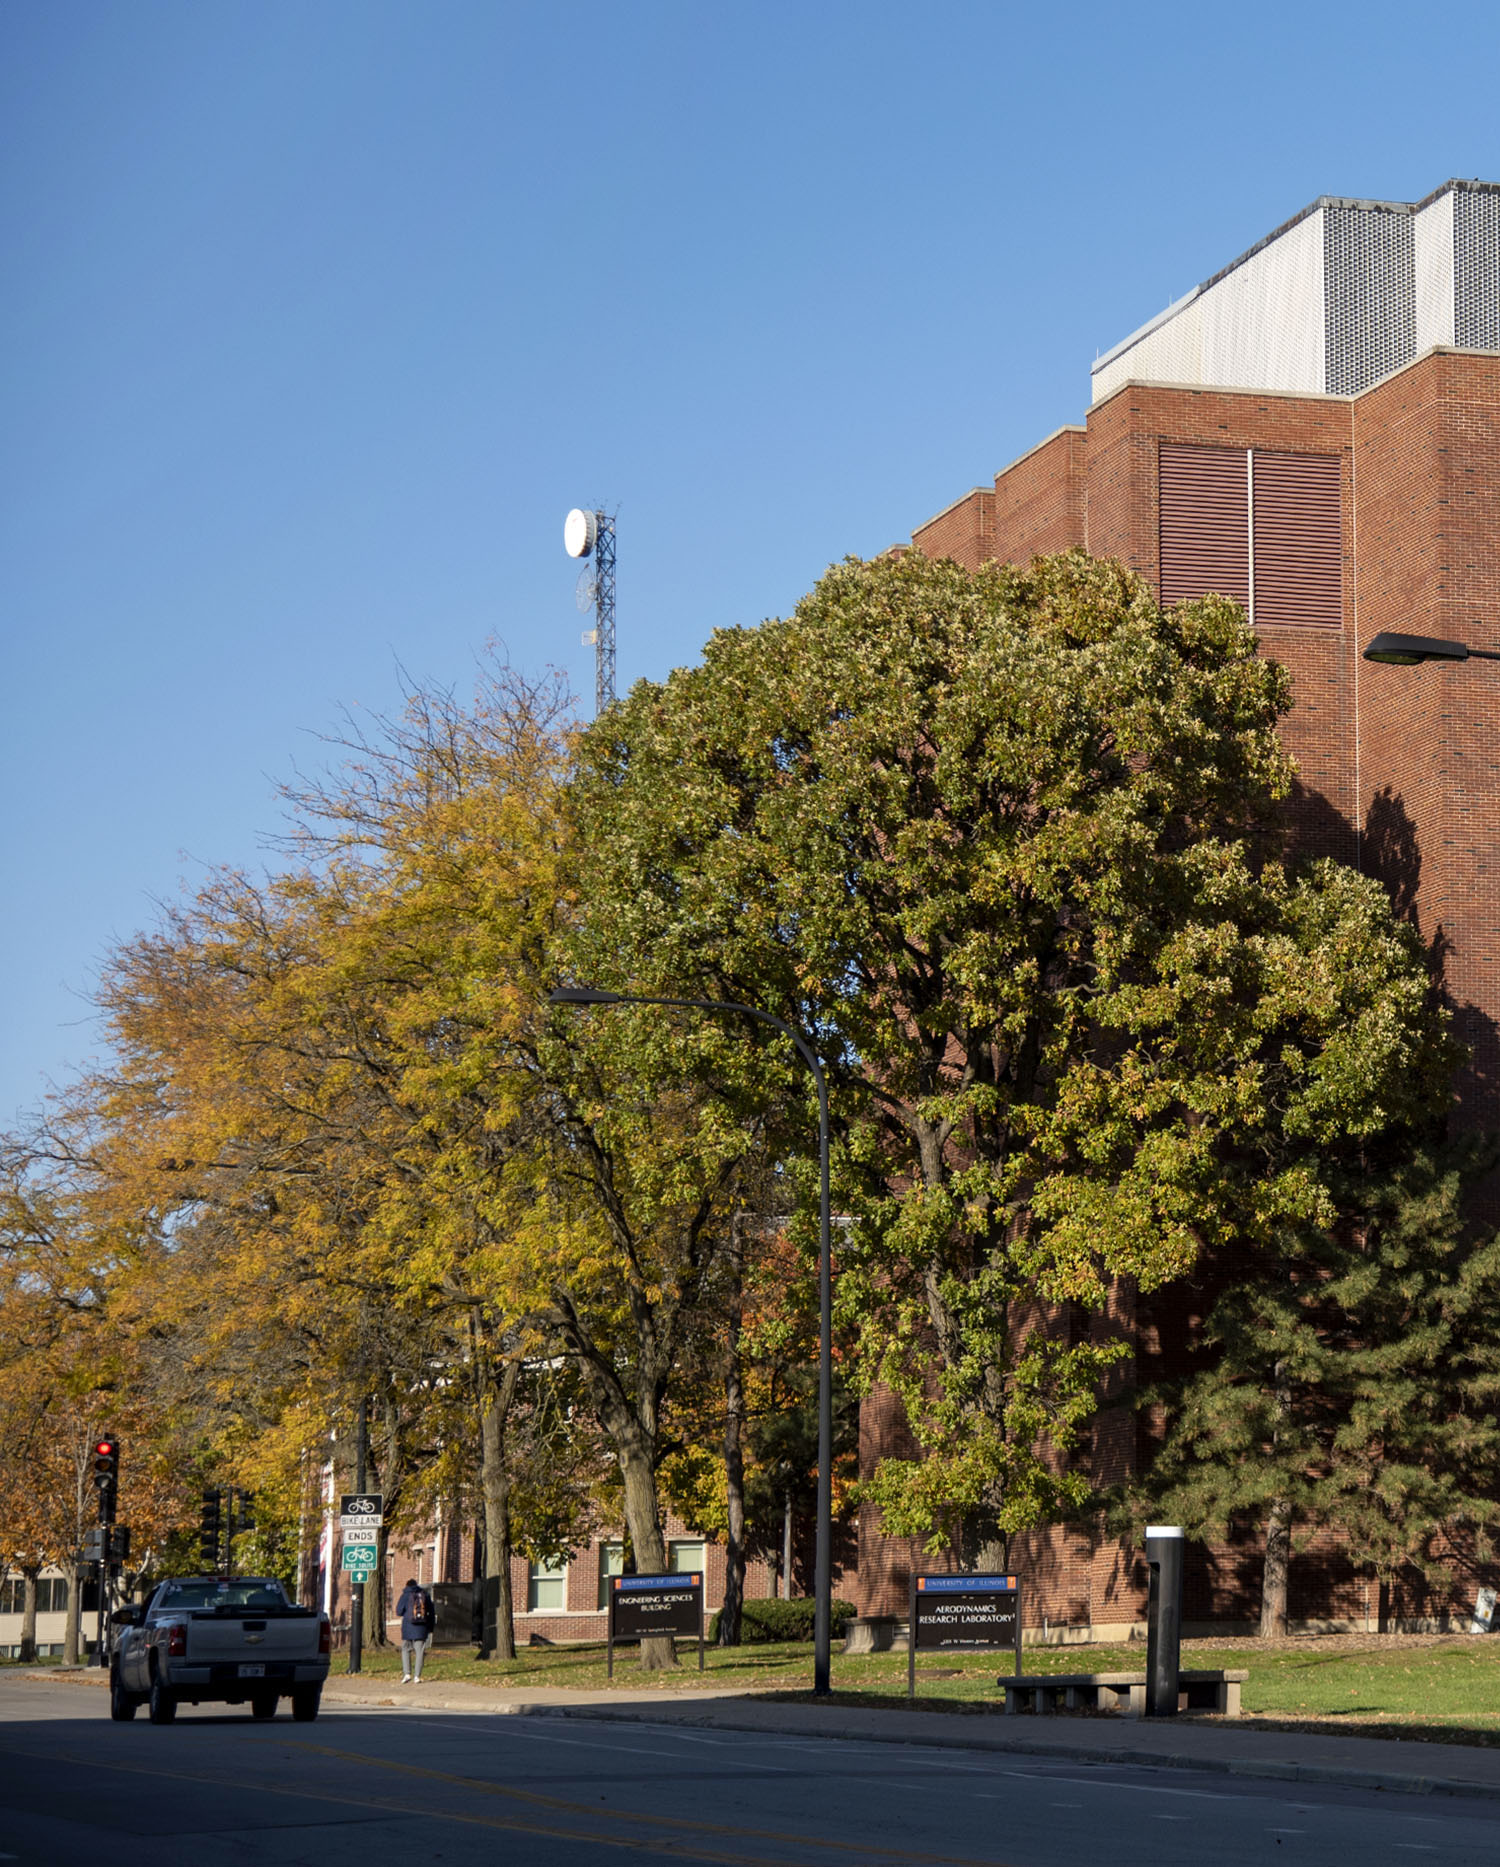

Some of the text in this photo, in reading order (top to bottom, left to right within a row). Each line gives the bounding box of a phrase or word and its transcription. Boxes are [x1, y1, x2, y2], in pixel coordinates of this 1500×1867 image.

[342, 1516, 380, 1525] BIKE LANE
[348, 1532, 373, 1541] ENDS
[618, 1594, 694, 1604] ENGINEERING SCIENCES
[935, 1605, 996, 1613] AERODYNAMICS
[919, 1614, 1012, 1623] RESEARCH LABORATORY
